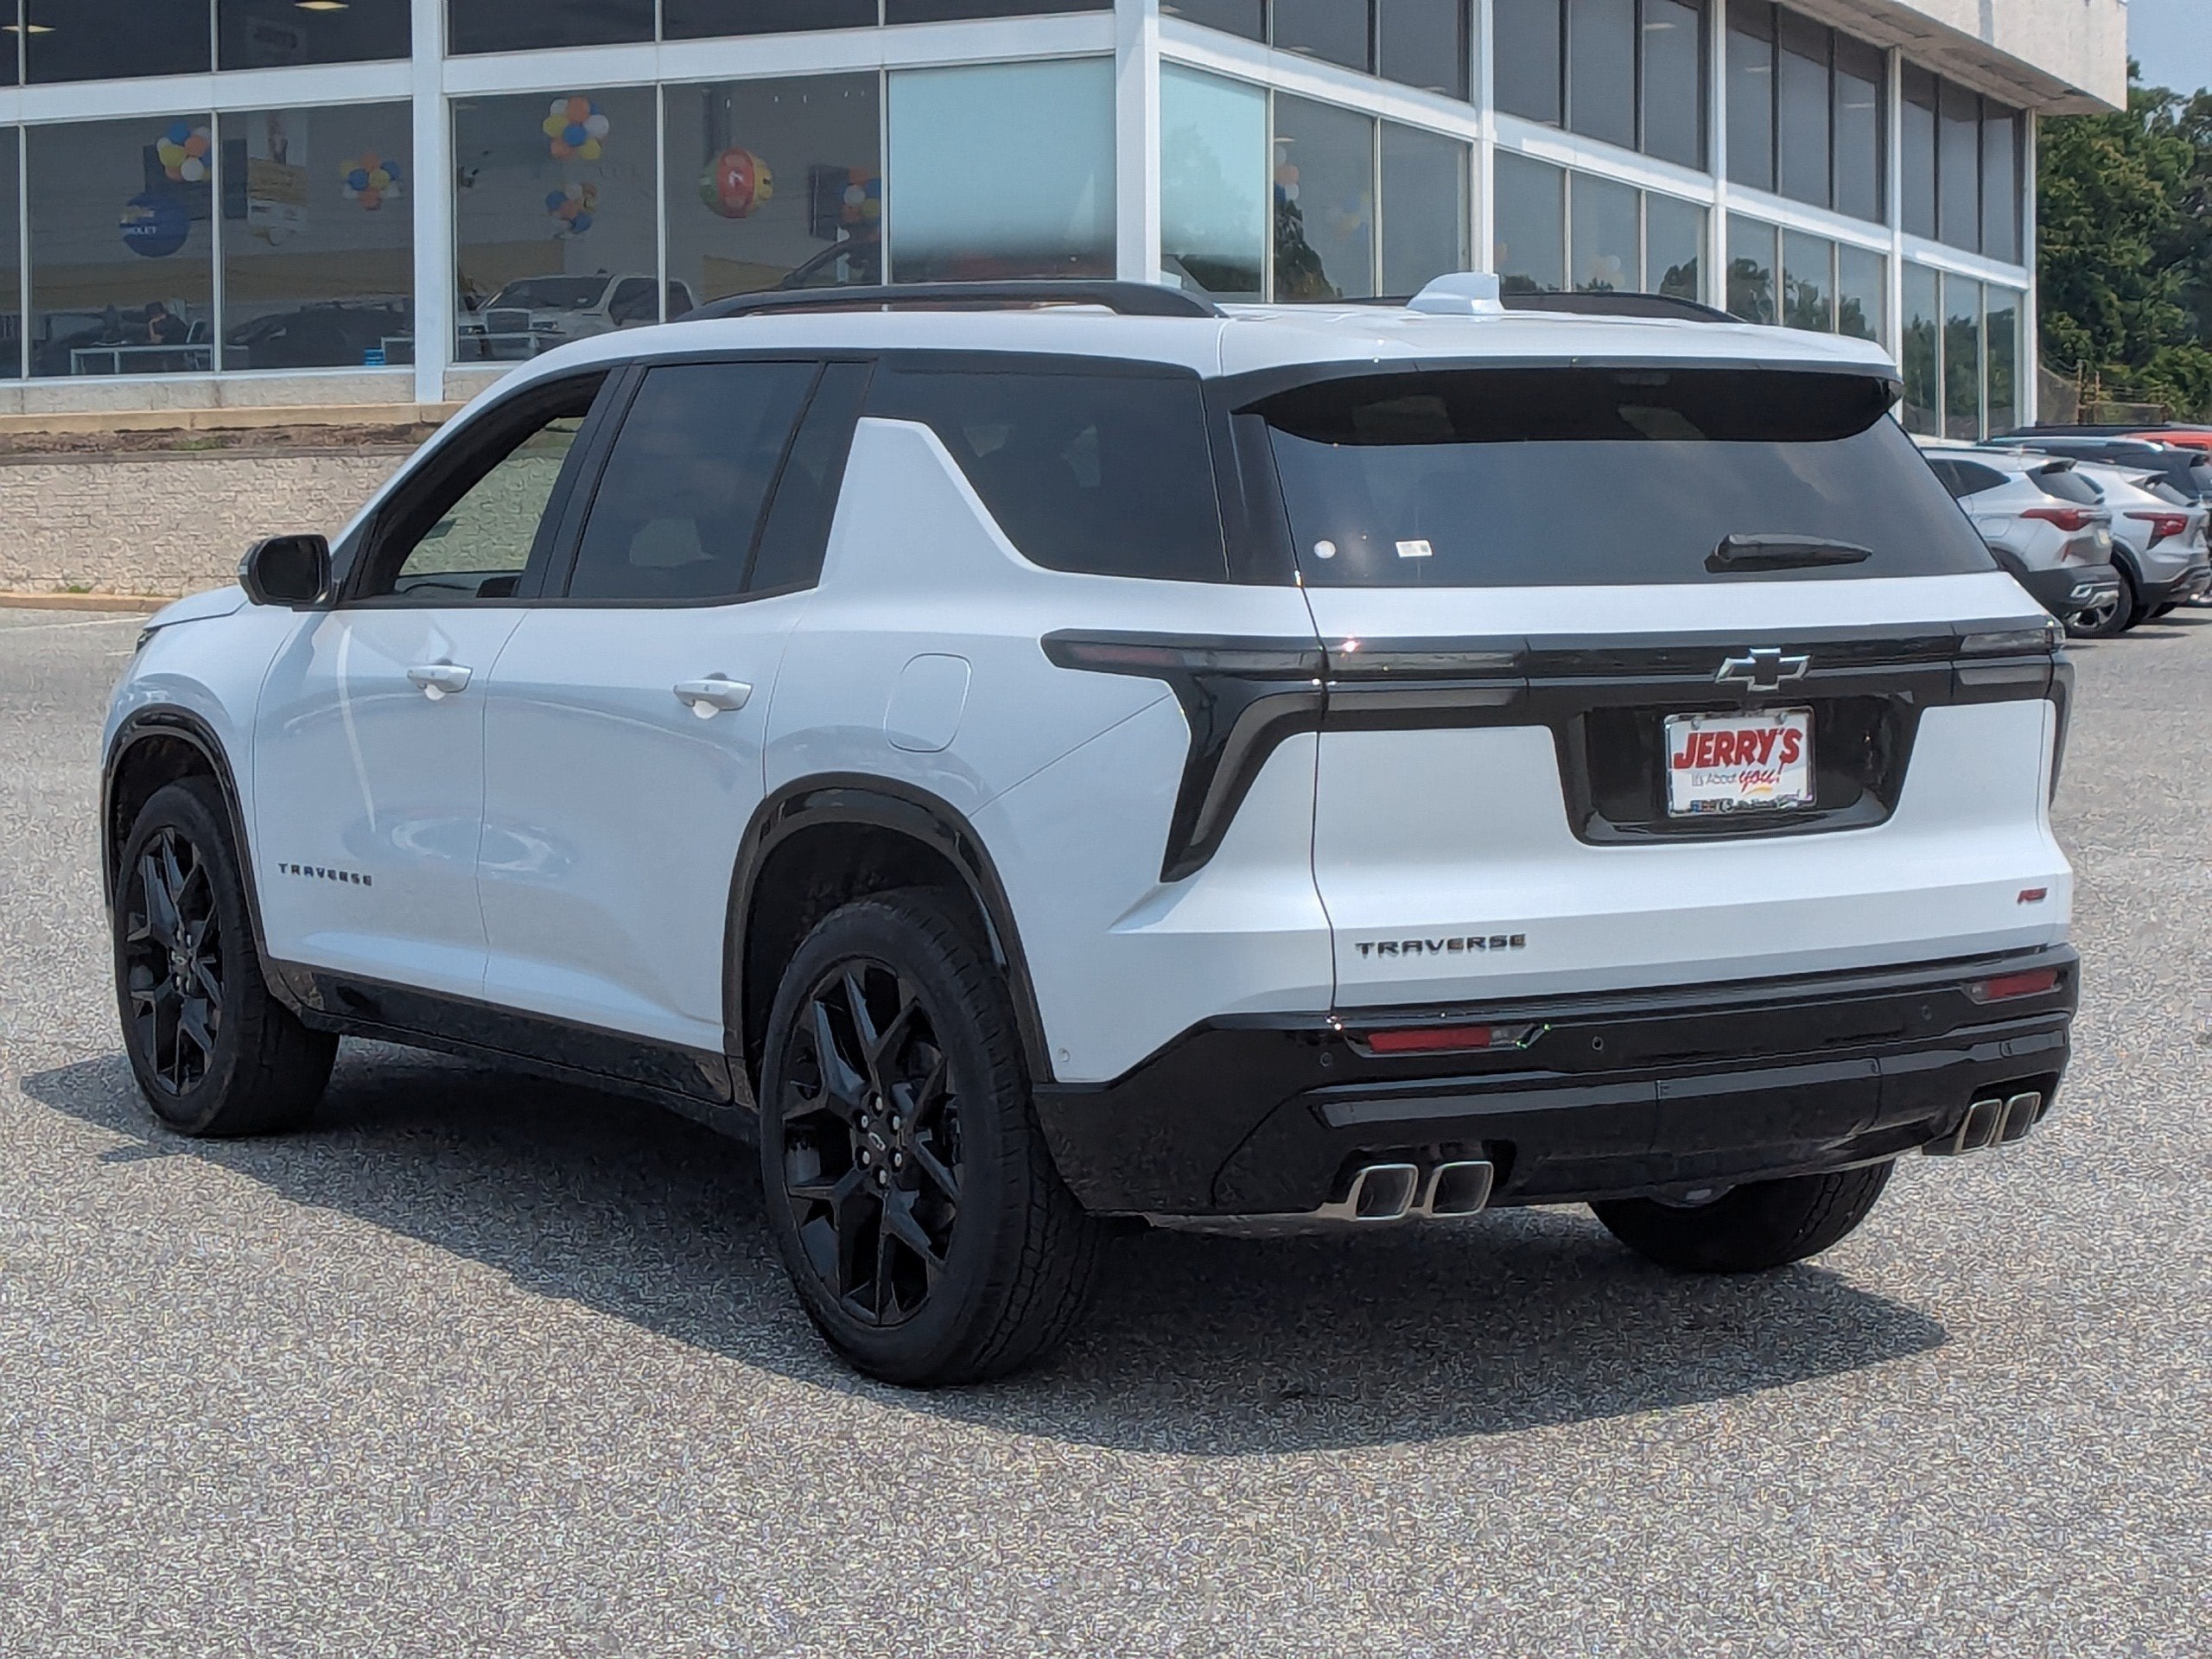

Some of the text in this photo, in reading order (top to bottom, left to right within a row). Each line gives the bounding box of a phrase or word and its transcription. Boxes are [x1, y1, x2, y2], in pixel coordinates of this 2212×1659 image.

[1673, 728, 1803, 769] JERRY'S
[278, 862, 372, 887] TRAVERSE
[1354, 933, 1527, 959] TRAVERSE
